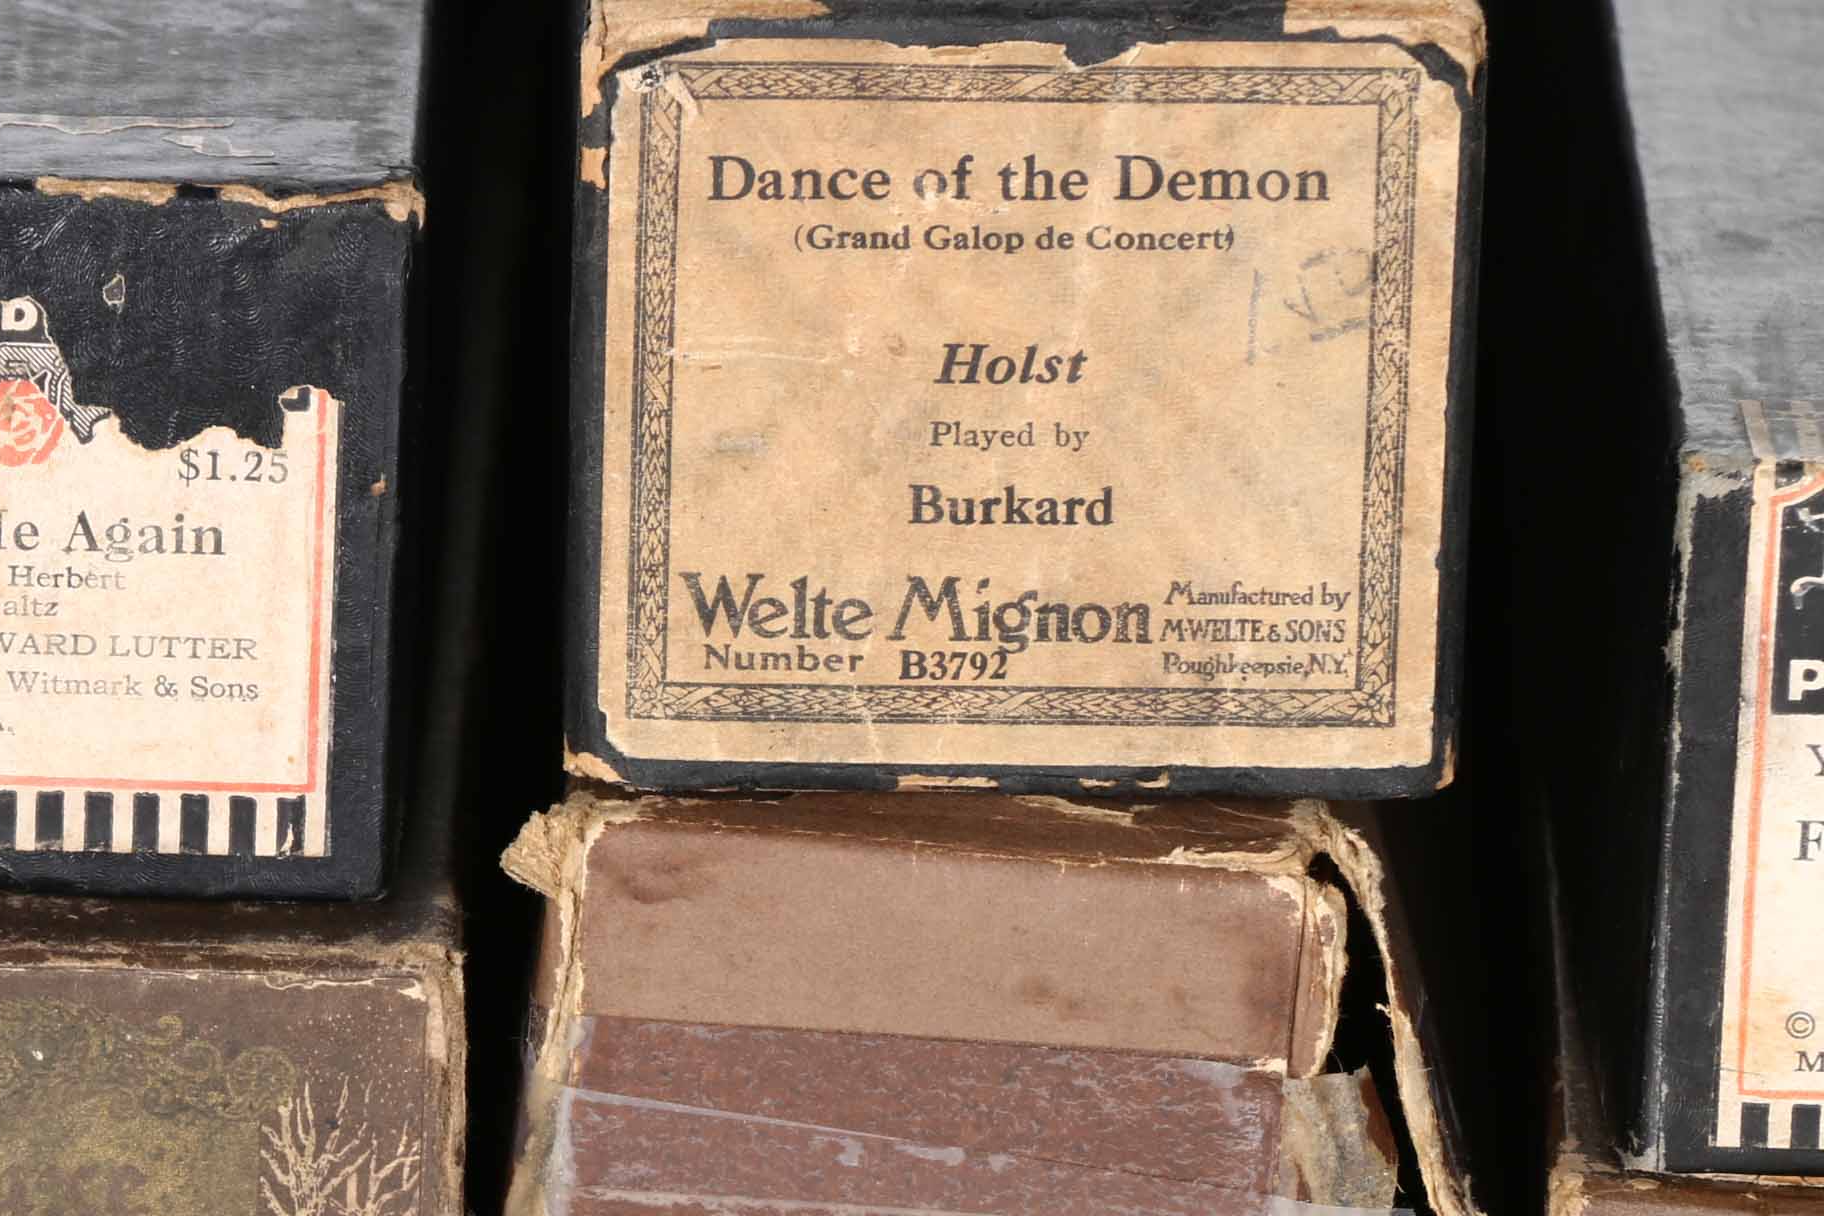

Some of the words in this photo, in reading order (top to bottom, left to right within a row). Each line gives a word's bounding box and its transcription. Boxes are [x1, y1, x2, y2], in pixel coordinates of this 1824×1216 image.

[707, 155, 890, 202] Dance
[913, 154, 974, 200] of
[997, 154, 1088, 201] the
[1114, 155, 1330, 202] Demon
[794, 224, 910, 252] (Grand
[924, 225, 1024, 254] Galop
[1035, 226, 1074, 250] de
[1086, 224, 1235, 252] Concert)
[933, 343, 1088, 385] Holst
[929, 421, 1035, 452] Played
[1054, 422, 1090, 452] by
[178, 447, 288, 487] $1.25
[908, 484, 1113, 526] Burkard
[62, 510, 225, 562] Again
[8, 565, 125, 589] Herbert
[678, 572, 874, 641] Welte
[886, 575, 1153, 654] Mignon
[1163, 580, 1313, 606] Manufactured
[1320, 582, 1351, 612] by
[109, 635, 258, 660] LUTTER
[1284, 619, 1346, 644] SONS
[703, 644, 864, 672] Number
[899, 646, 1008, 680] B3792
[6, 670, 142, 696] Witmark
[190, 675, 259, 702] Sons
